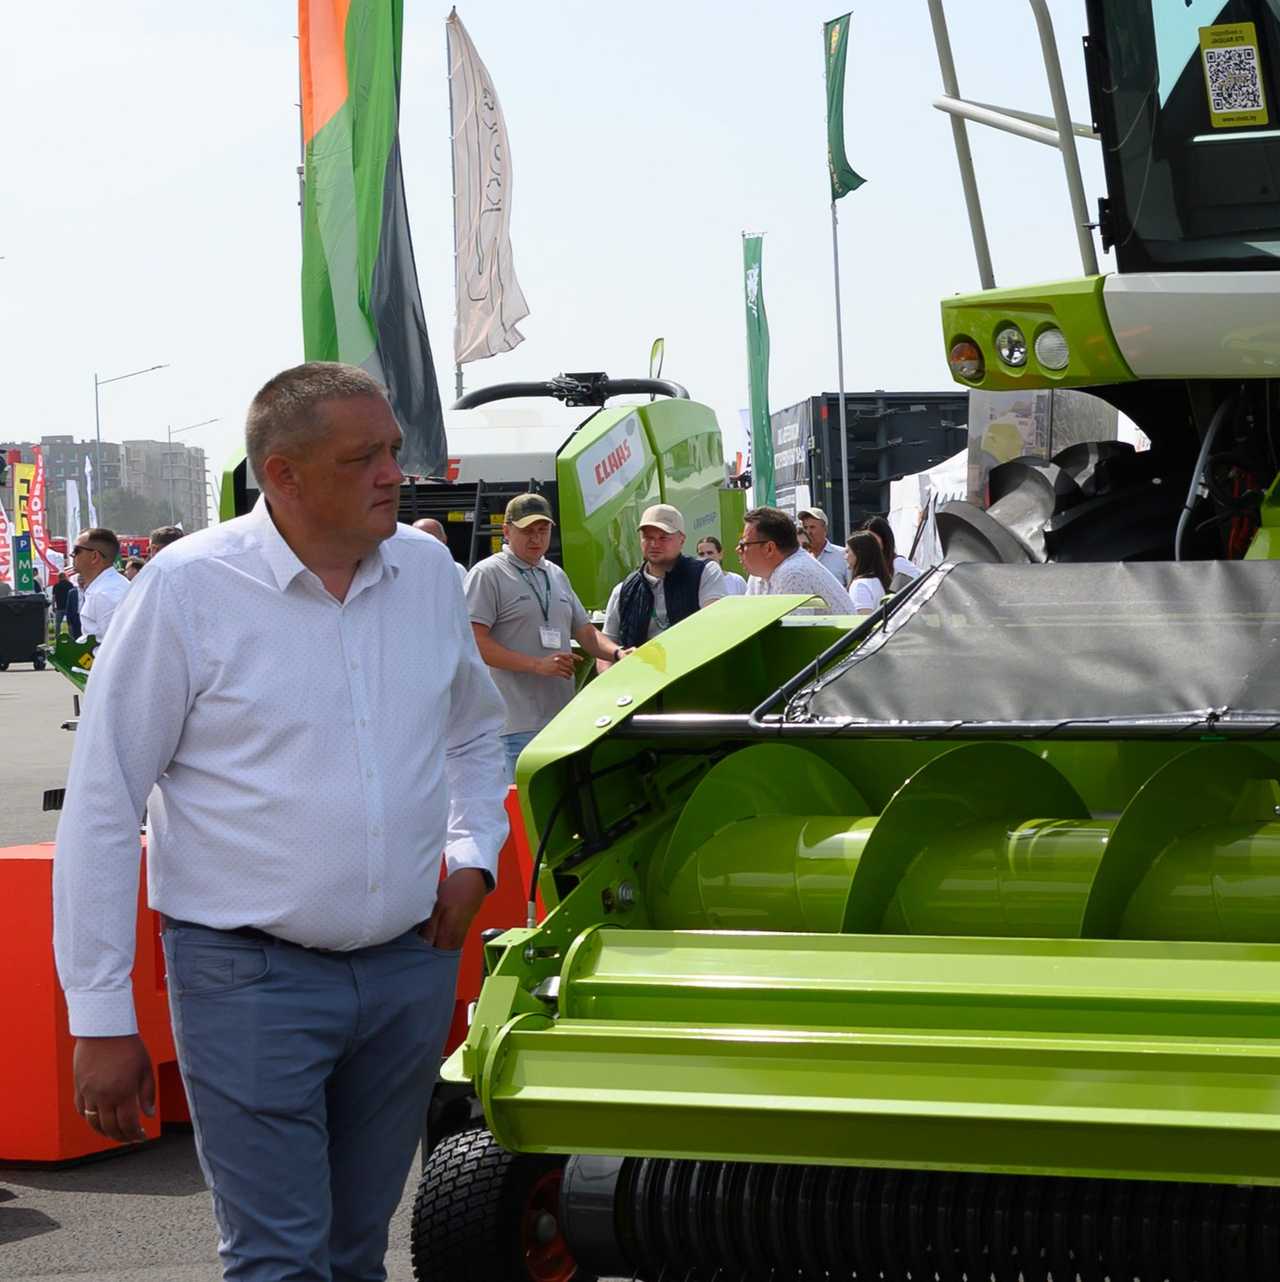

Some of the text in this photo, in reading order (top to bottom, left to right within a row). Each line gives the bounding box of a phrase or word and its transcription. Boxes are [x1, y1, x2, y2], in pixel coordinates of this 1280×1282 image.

[594, 439, 632, 485] CLAAS
[20, 540, 28, 549] P
[21, 573, 30, 584] 6
